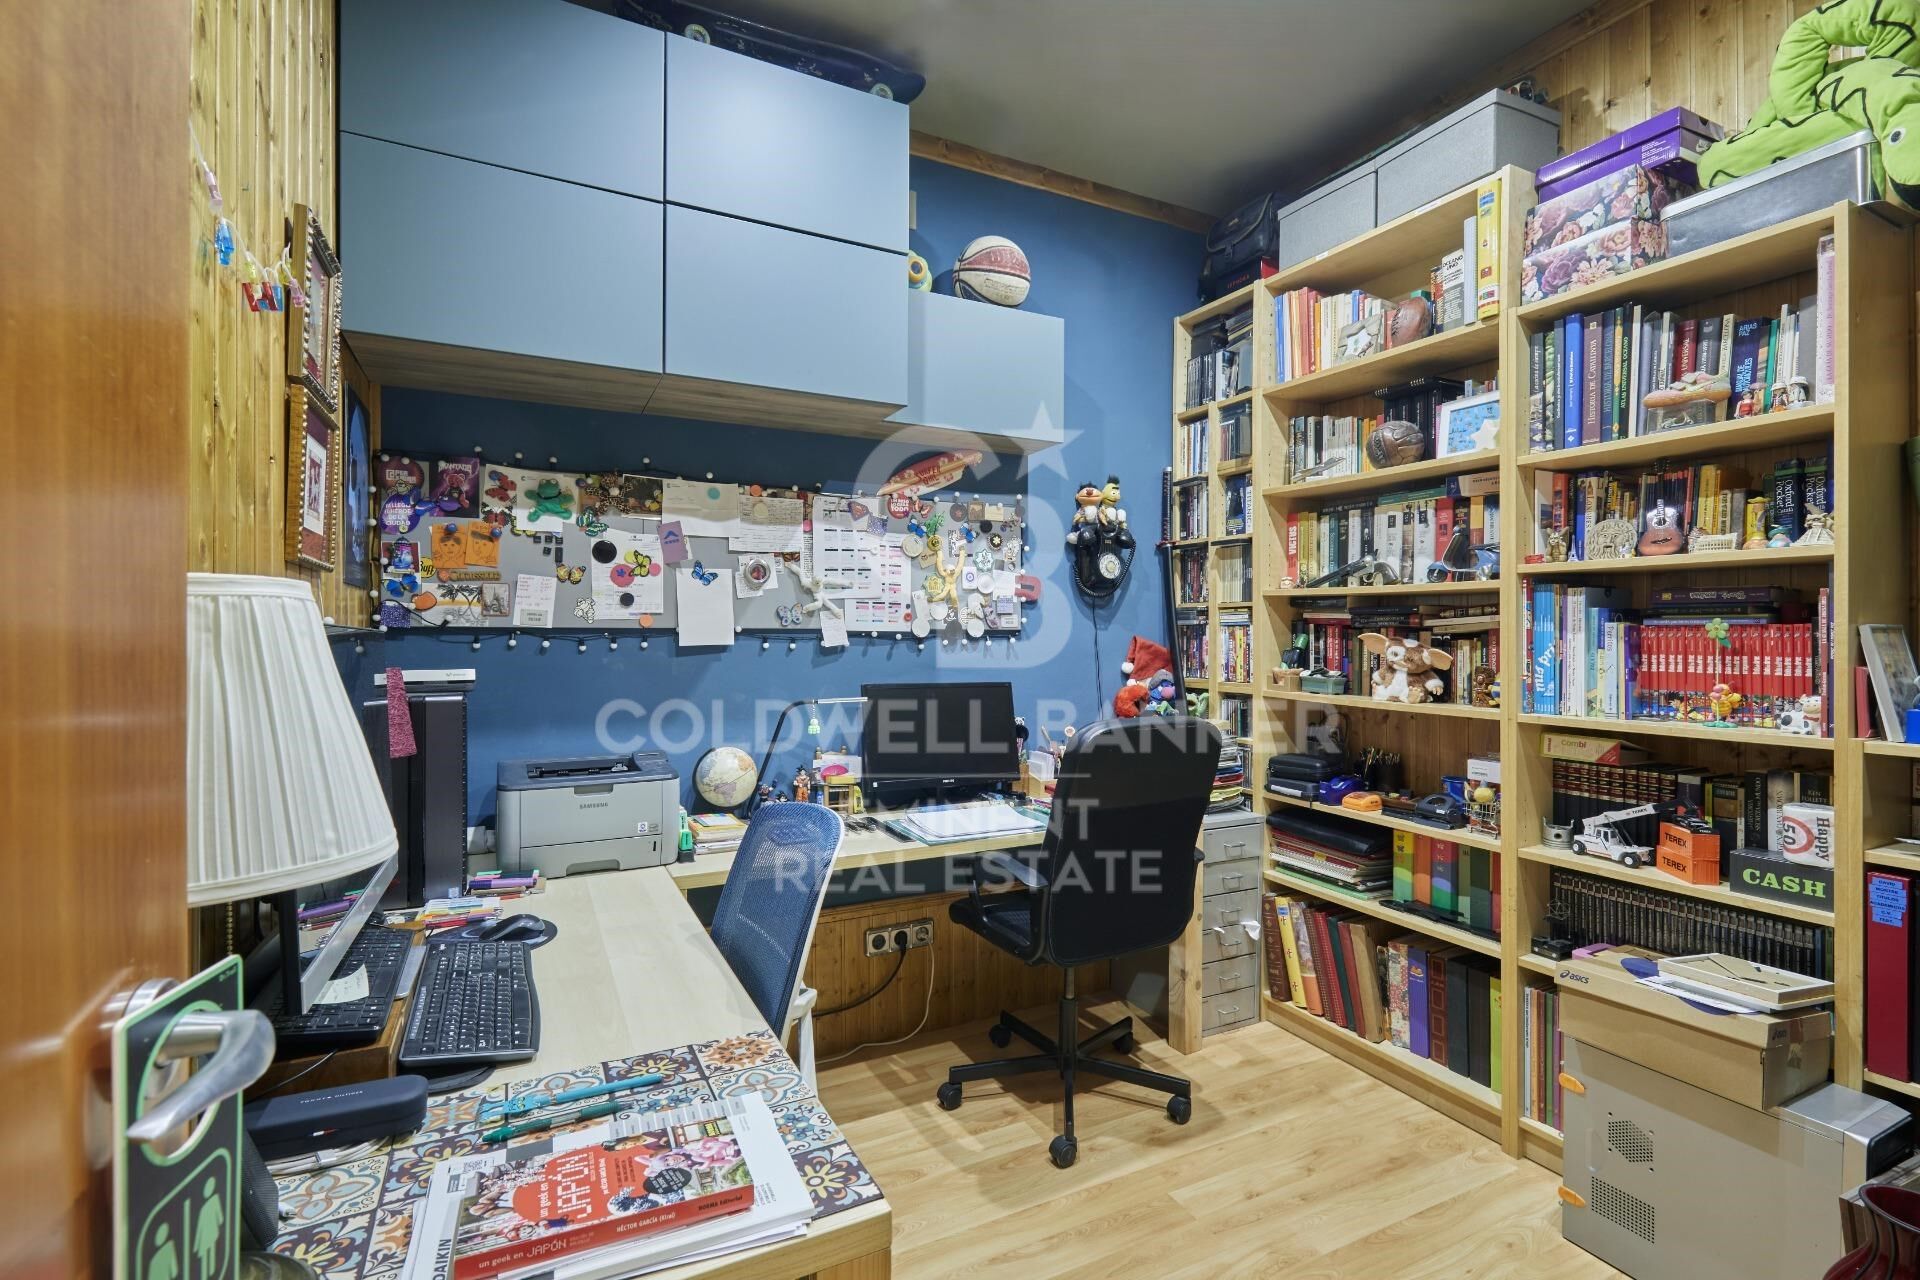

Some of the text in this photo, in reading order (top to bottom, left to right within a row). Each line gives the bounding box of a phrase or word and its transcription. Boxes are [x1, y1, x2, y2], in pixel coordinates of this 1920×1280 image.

[1739, 322, 1758, 332] ARIAS
[1776, 479, 1795, 508] Oxford Pocket
[1806, 476, 1826, 505] Oxford Pocke
[1288, 526, 1297, 555] VICTUS
[1665, 832, 1687, 849] TEREX
[1783, 823, 1796, 846] 50
[1816, 817, 1830, 862] Happy
[1663, 856, 1687, 873] TEREX
[1743, 868, 1826, 898] CASH
[1570, 973, 1590, 984] asics
[537, 1183, 551, 1218] un geek en
[549, 1153, 593, 1219] JAPÓN
[491, 1255, 511, 1267] geek
[527, 1237, 567, 1257] JAPÓN
[616, 1221, 638, 1233] HÉCTOR
[639, 1216, 658, 1228] GARCÍA
[699, 1201, 718, 1211] NORMA
[432, 1239, 452, 1280] DAIKIN
